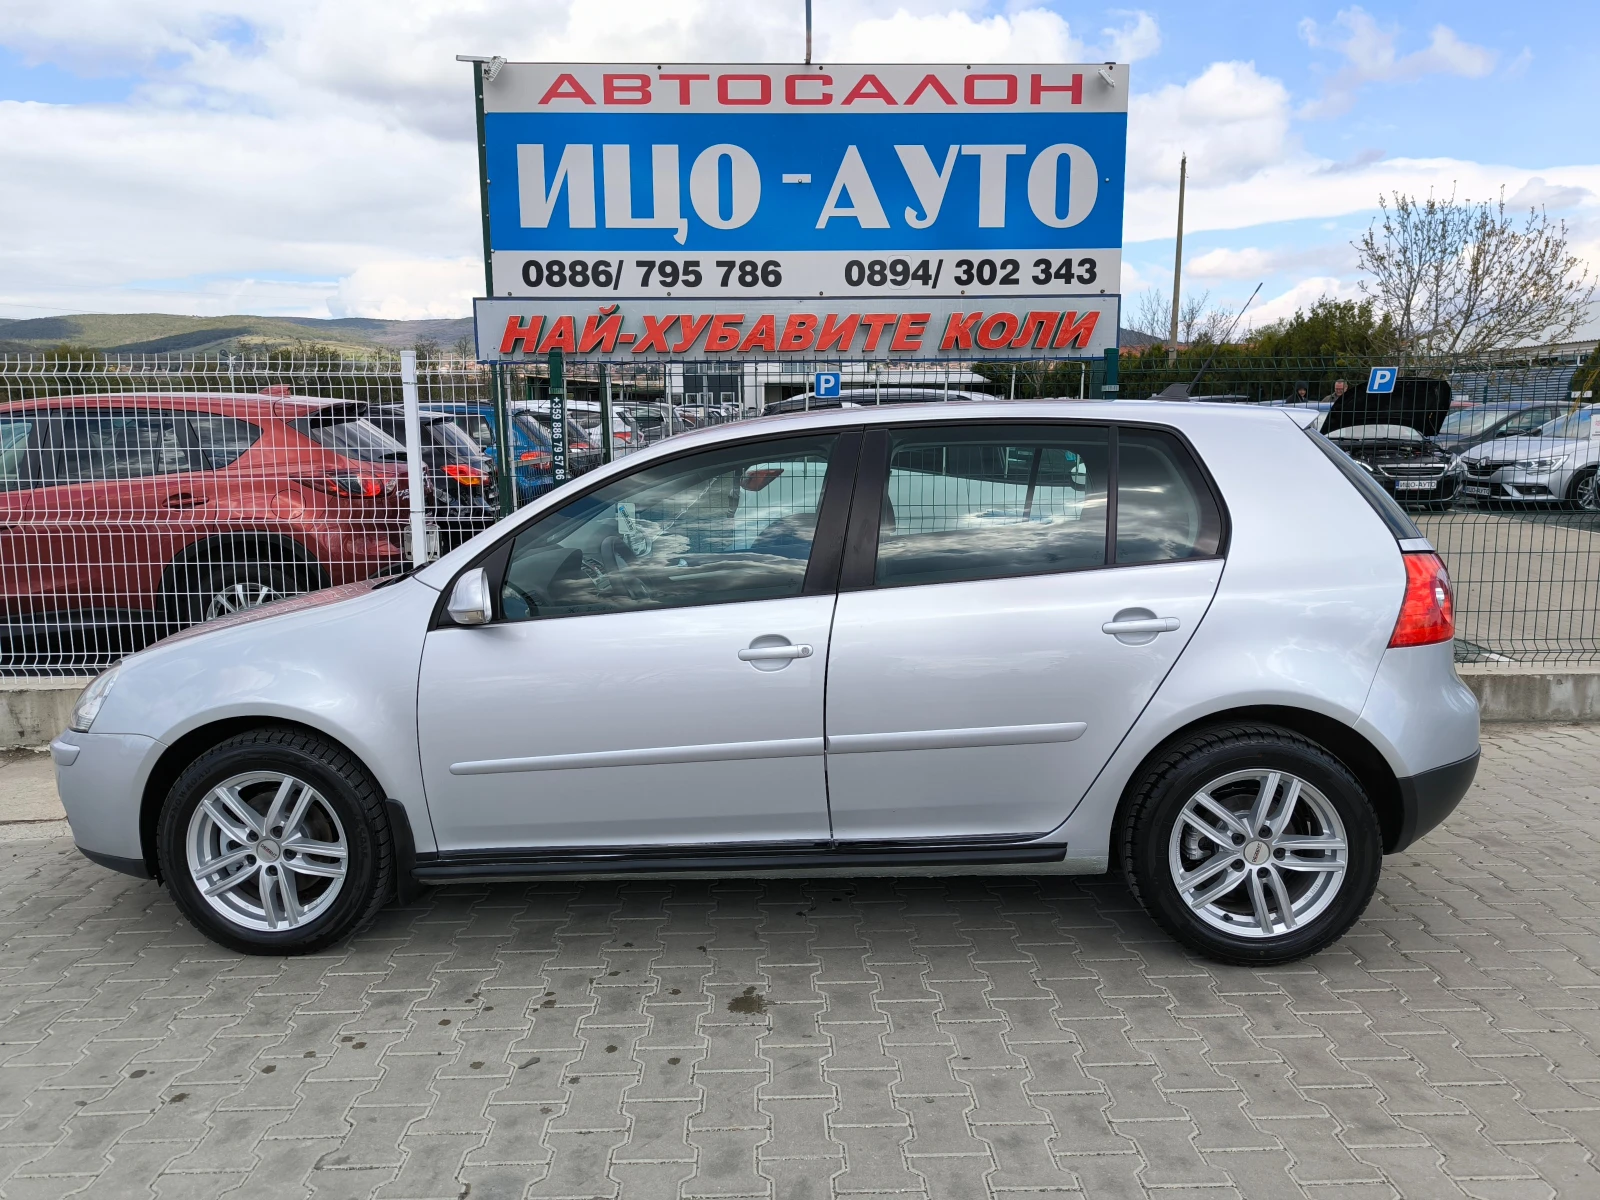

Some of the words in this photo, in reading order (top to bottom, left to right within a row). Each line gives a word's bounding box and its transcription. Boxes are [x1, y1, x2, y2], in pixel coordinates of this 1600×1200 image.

[539, 73, 1083, 106] АВТОСАЛОН
[517, 143, 761, 245] ИЦО
[816, 143, 1099, 229] АУТО
[521, 259, 624, 291] 0886/
[635, 260, 703, 288] 795
[715, 259, 782, 288] 786
[844, 258, 944, 289] 0894/
[953, 258, 1020, 286] 302
[1031, 257, 1097, 286] 343
[498, 303, 932, 355] НАЙ-ХУБАВИТЕ
[940, 311, 1101, 352] КОЛИ
[820, 375, 835, 395] P
[1373, 370, 1391, 390] P
[552, 396, 561, 420] +359
[552, 422, 562, 439] 886
[553, 441, 563, 453] 79
[554, 455, 564, 467] 57
[555, 468, 565, 480] 86
